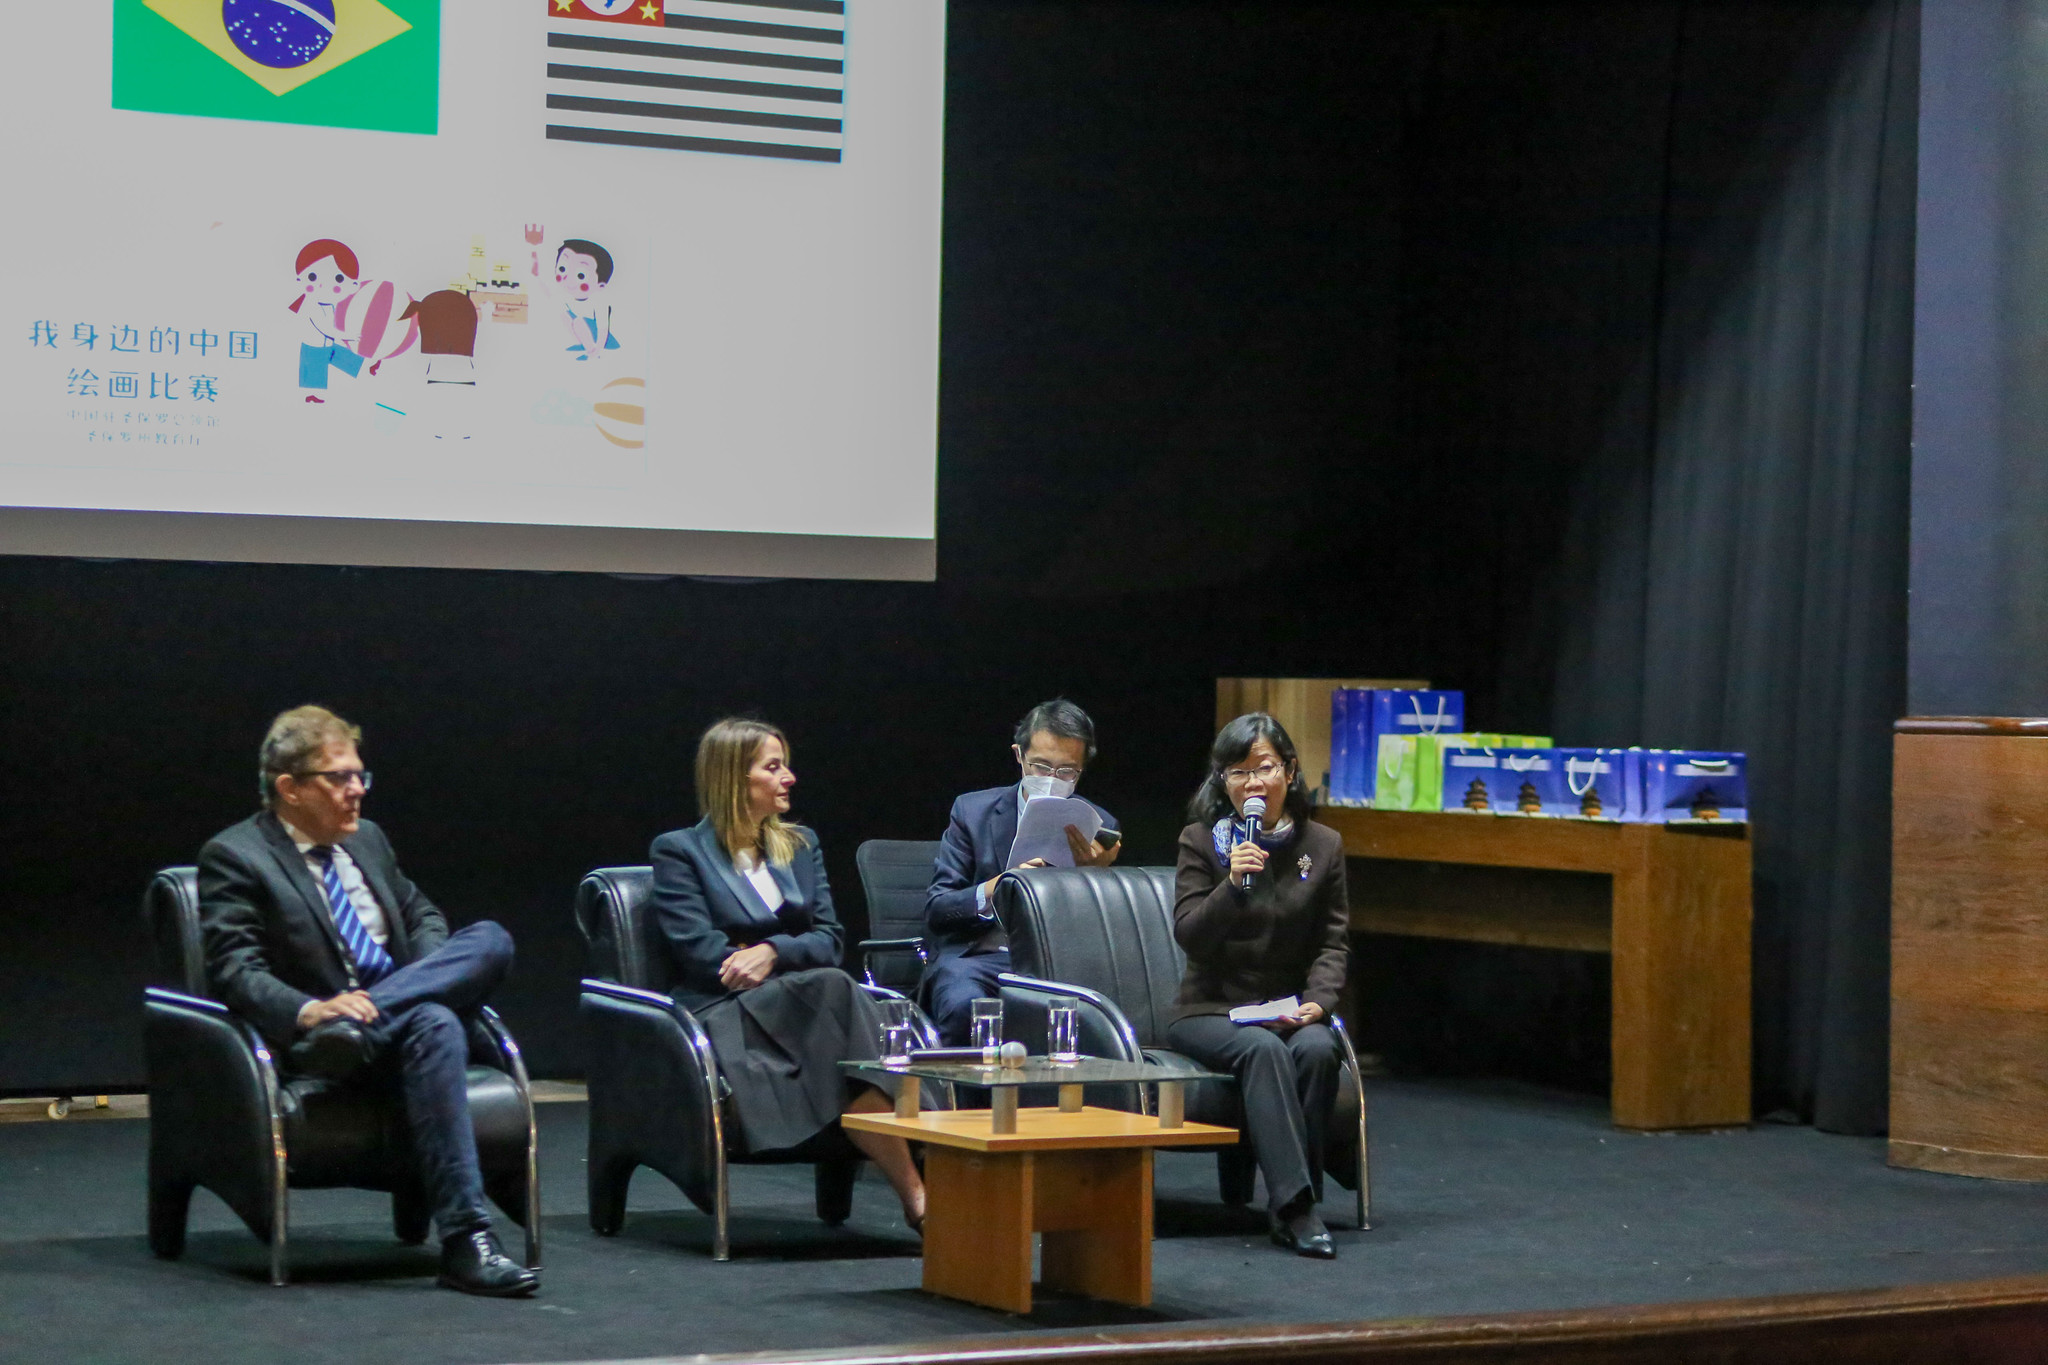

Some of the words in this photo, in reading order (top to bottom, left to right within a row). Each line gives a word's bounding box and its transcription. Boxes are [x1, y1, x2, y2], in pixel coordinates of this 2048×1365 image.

[28, 319, 258, 359] 我身边的中国
[66, 367, 219, 403] 绘画比赛
